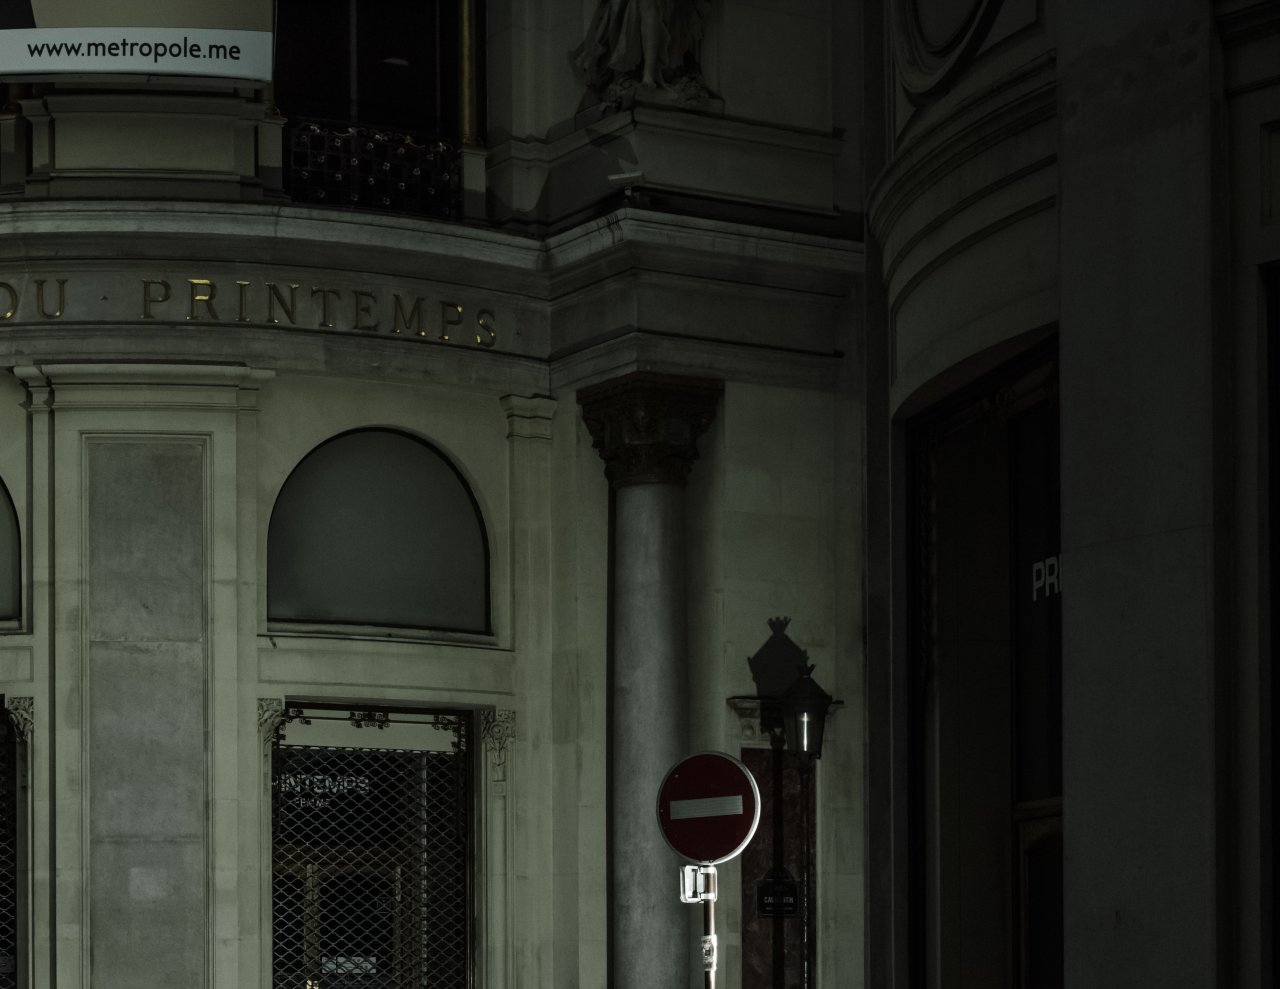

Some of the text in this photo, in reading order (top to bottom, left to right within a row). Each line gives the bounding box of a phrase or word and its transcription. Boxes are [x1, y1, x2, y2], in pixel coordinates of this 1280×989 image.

[27, 36, 241, 63] www.metropole.me
[141, 278, 498, 348] PRINTEMPS
[271, 773, 370, 794] INTEMPS
